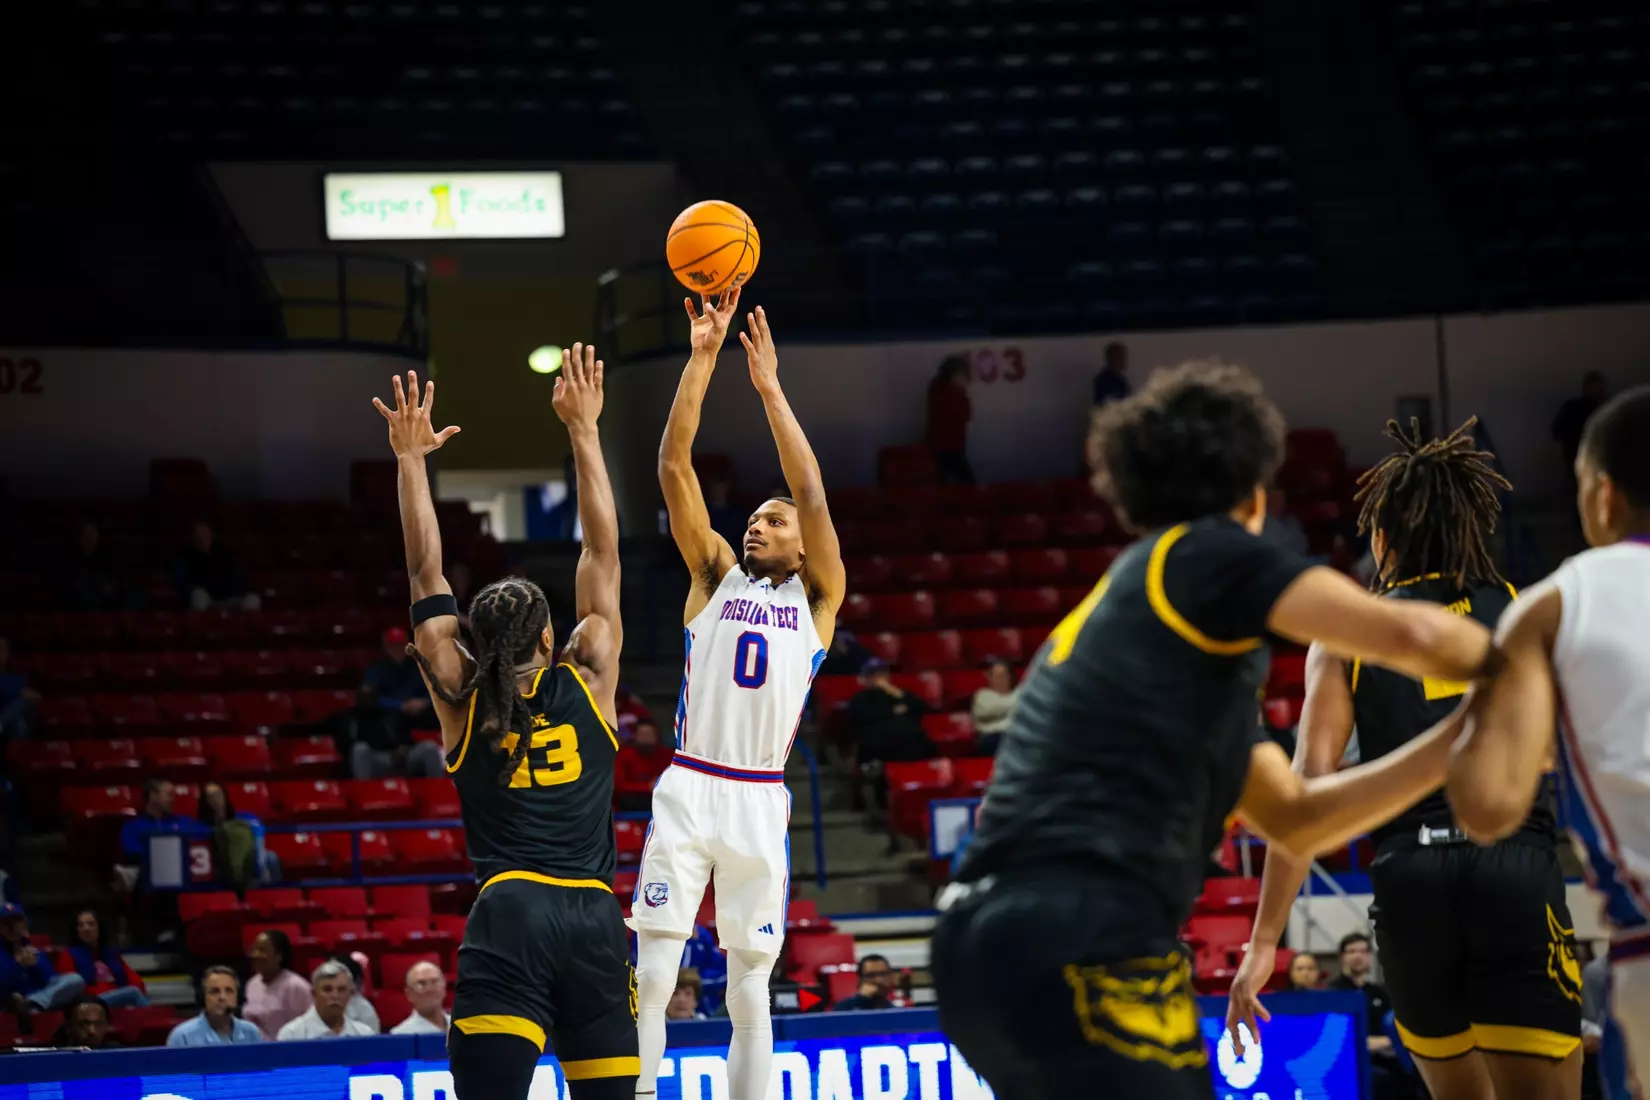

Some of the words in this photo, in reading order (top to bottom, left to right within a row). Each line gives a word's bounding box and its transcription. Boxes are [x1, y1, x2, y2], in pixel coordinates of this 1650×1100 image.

[339, 188, 423, 221] Super
[459, 188, 546, 214] Foods
[964, 347, 1026, 383] 03
[769, 604, 799, 631] TECH
[733, 630, 768, 689] 0
[189, 846, 212, 876] 3
